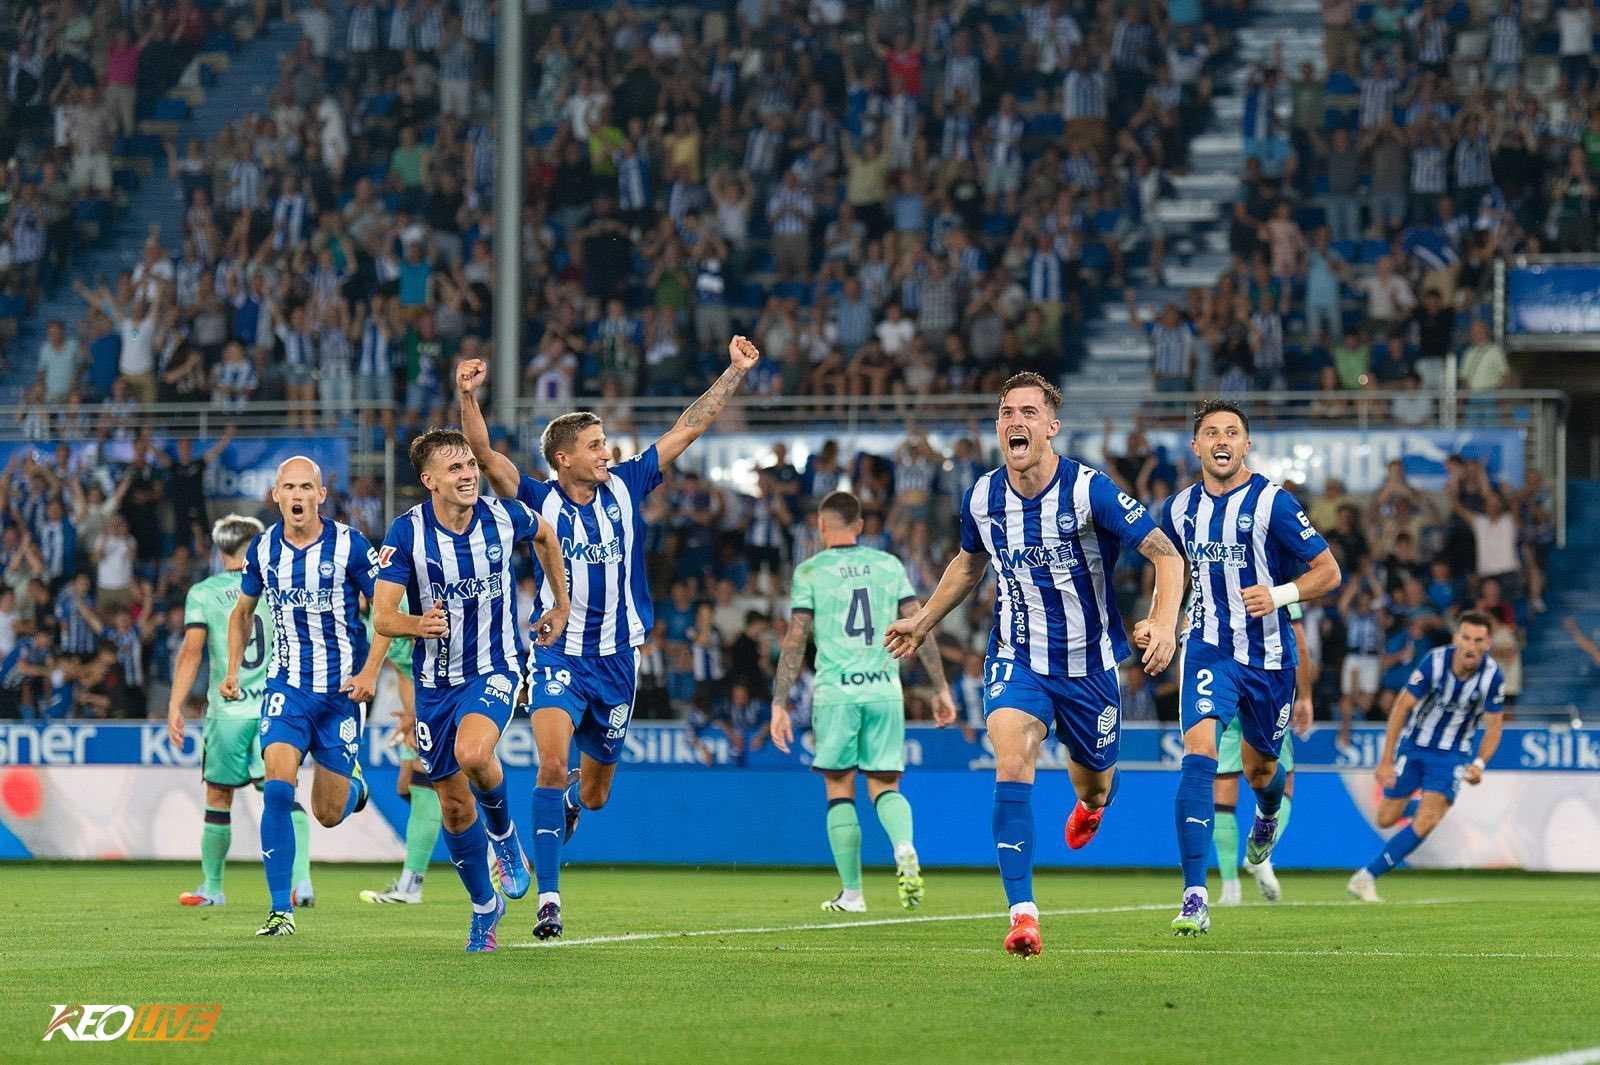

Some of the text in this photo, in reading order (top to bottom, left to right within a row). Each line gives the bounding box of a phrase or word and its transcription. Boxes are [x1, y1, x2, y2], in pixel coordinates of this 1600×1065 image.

[840, 564, 871, 579] DELA
[1055, 558, 1079, 571] NEWS
[845, 587, 875, 646] 4
[1196, 668, 1214, 696] 2
[484, 687, 510, 705] EMB
[1096, 732, 1117, 749] EMB
